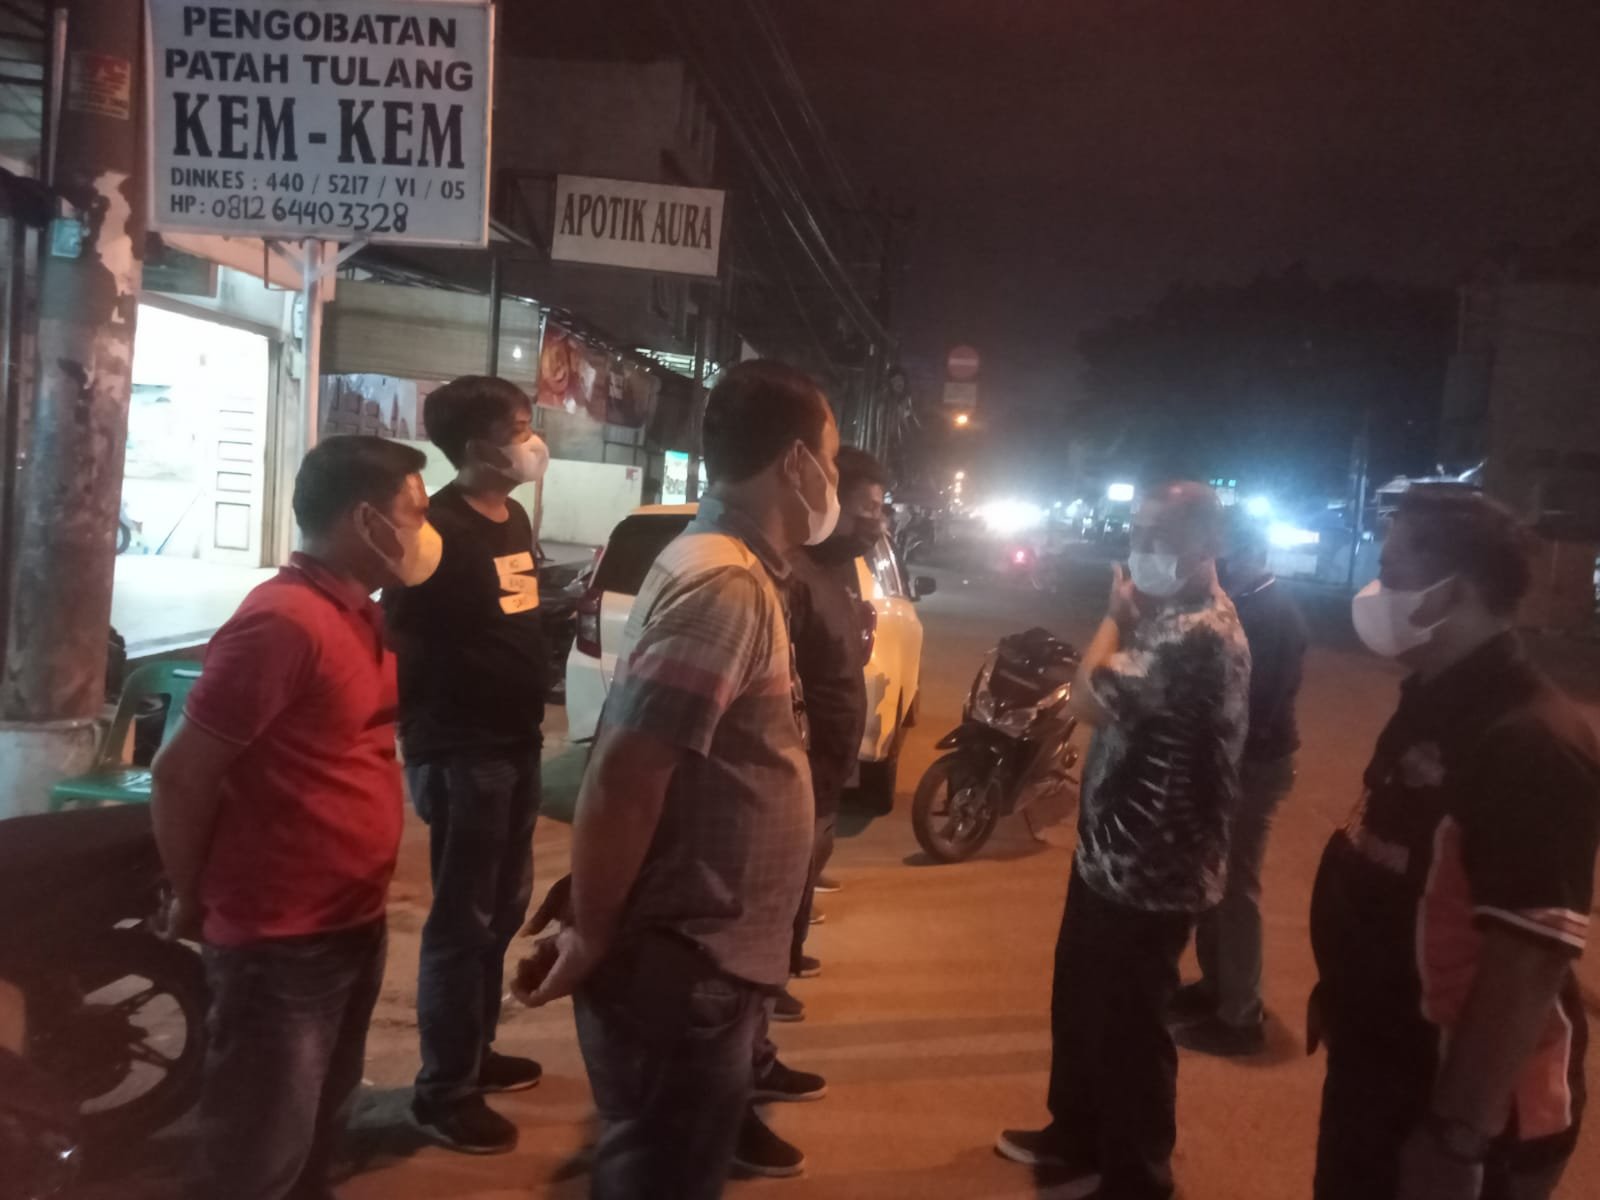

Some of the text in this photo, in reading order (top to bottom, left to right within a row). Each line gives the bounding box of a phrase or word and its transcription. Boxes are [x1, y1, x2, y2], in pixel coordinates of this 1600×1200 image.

[183, 6, 457, 48] PENGOBATAN
[165, 48, 473, 91] PATAH TULANG
[266, 172, 304, 193] 440
[328, 174, 369, 195] 5217
[441, 179, 465, 200] 05
[560, 192, 713, 249] APOTIK AURA
